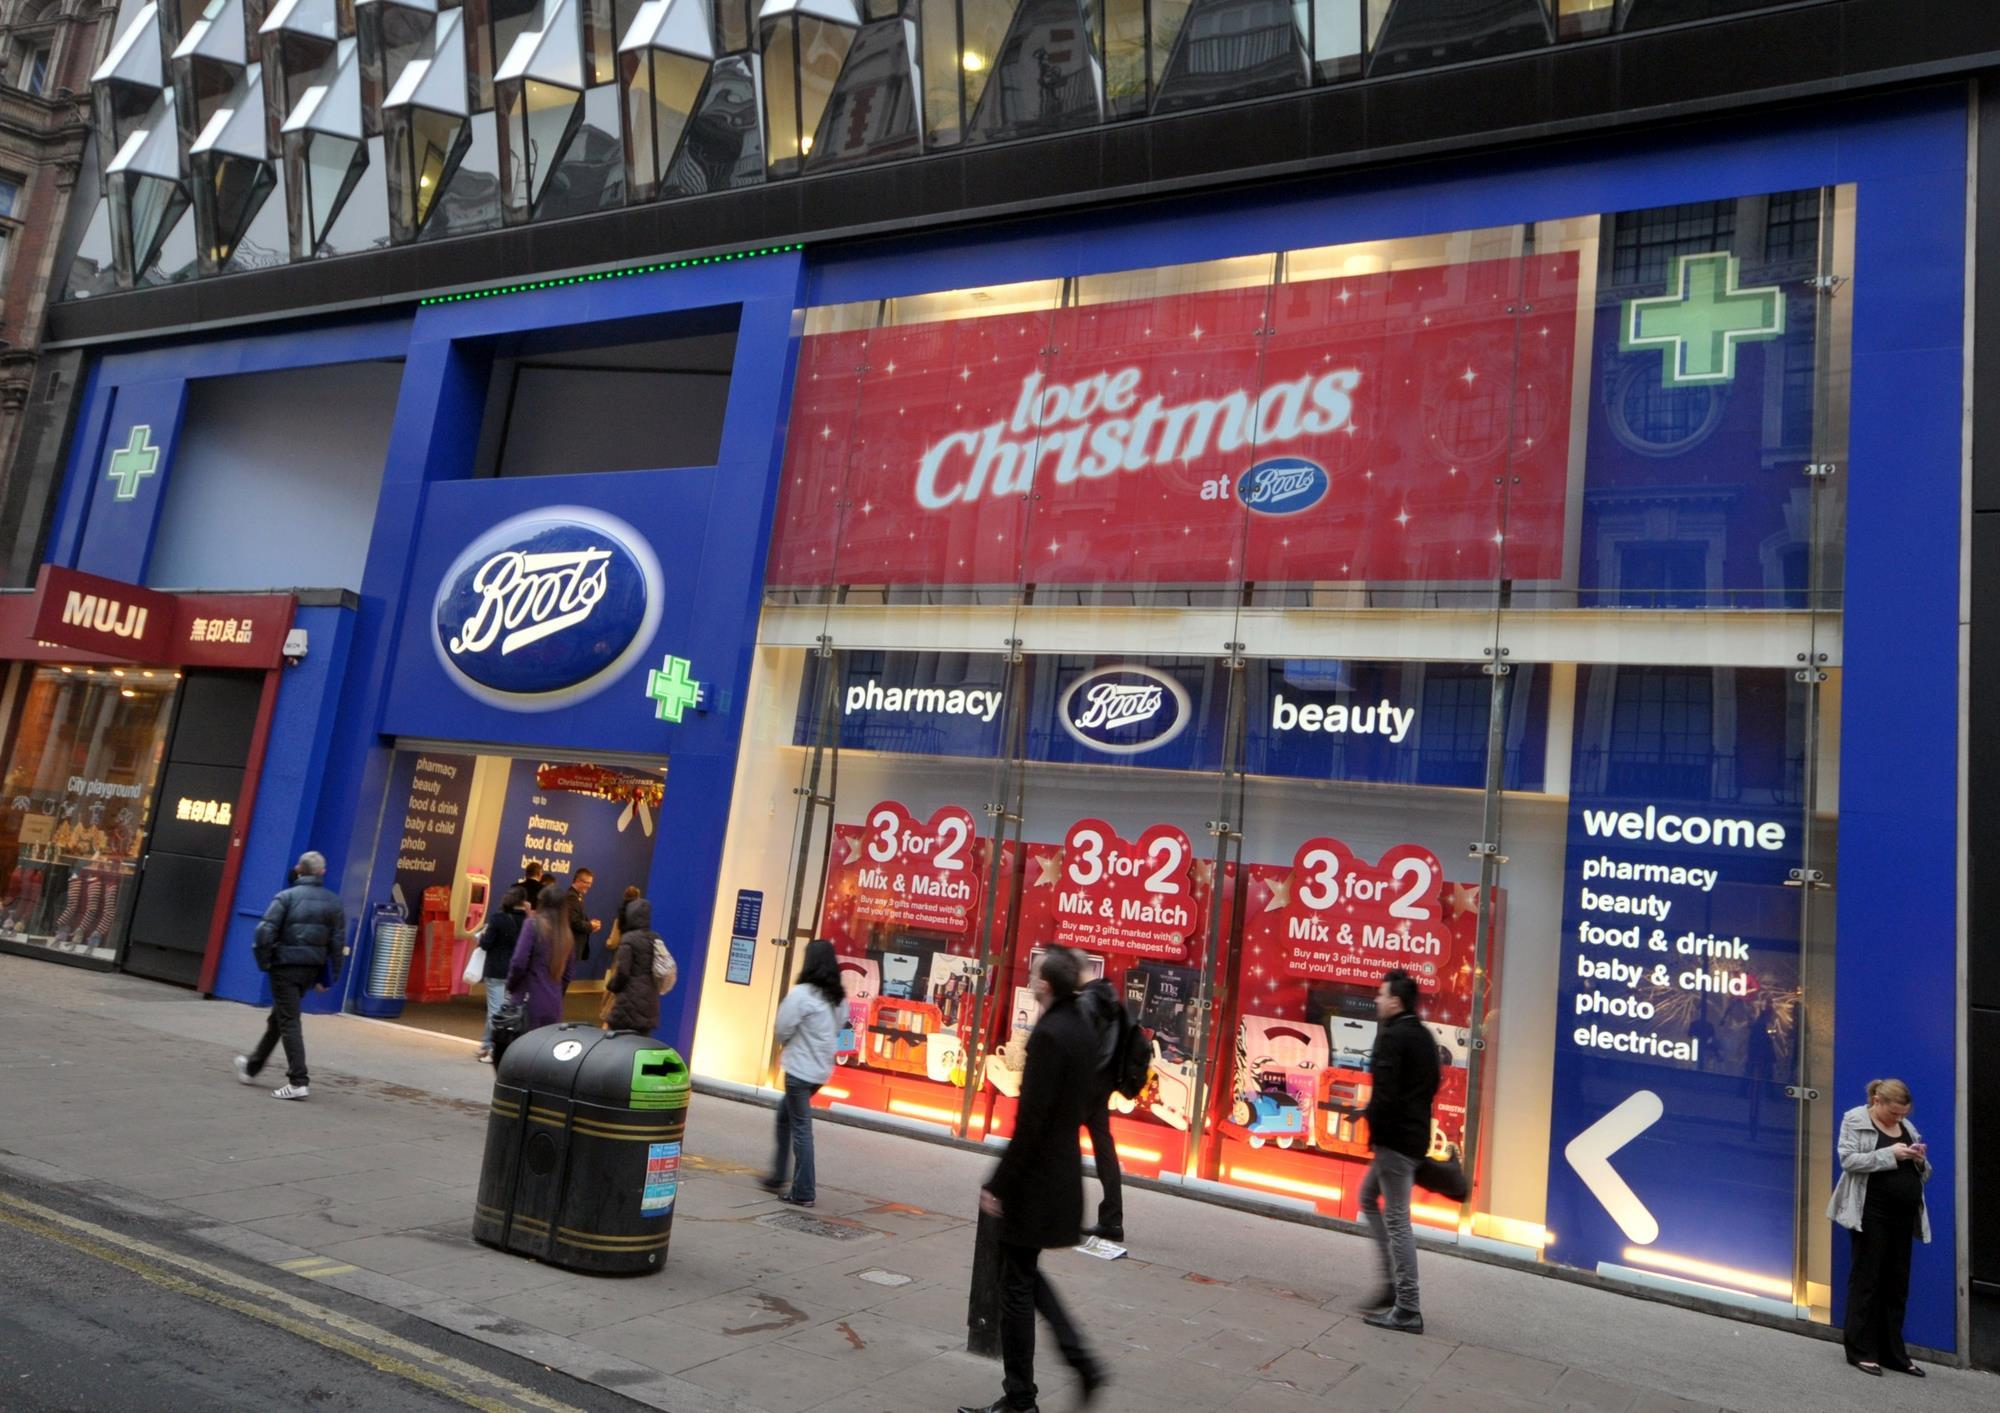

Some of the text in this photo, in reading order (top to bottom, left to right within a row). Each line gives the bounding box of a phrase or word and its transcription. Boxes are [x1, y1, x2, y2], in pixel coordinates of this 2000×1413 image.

[1011, 367, 1141, 432] love
[915, 369, 1361, 509] Christmas
[1200, 466, 1315, 503] at Boots
[62, 590, 149, 640] MUJI
[449, 546, 613, 656] Boots
[190, 618, 253, 643] 無印良品
[845, 679, 1002, 722] pharmacy
[1074, 683, 1162, 730] Boots
[1272, 694, 1414, 743] beauty
[416, 757, 457, 779] pharmacy
[67, 776, 142, 799] City playground
[412, 776, 441, 796] beauty
[176, 797, 232, 825] 無印良品
[409, 795, 458, 816] food & drink
[405, 816, 456, 835] baby & child
[528, 814, 569, 835] pharmacy
[1583, 805, 1785, 850] welcome
[400, 835, 426, 851] photo
[525, 834, 574, 854] food & drink
[868, 811, 967, 870] 3 for 2
[397, 857, 436, 872] electrical
[543, 858, 549, 871] &
[551, 859, 570, 874] child
[1069, 830, 1182, 894] 3 for 2
[1582, 855, 1718, 892] pharmacy
[858, 869, 970, 900] Mix & Match
[1299, 849, 1432, 920] 3 for 2
[903, 910, 914, 919] the
[916, 913, 948, 924] cheapest
[949, 917, 964, 926] free
[911, 902, 938, 912] marked
[939, 905, 955, 914] with
[1058, 892, 1188, 926] Mix & Match
[1581, 887, 1672, 922] beauty
[1059, 931, 1073, 940] and
[1097, 936, 1110, 946] get
[1112, 937, 1125, 947] the
[1127, 940, 1163, 952] cheapest
[1165, 945, 1181, 954] free
[1062, 920, 1171, 941] Buy any 3 gifts marked with
[1288, 916, 1440, 956] Mix & Match
[1579, 921, 1750, 961] food & drink
[1289, 960, 1307, 970] and
[1336, 966, 1351, 977] get
[1353, 968, 1368, 979] the
[1416, 975, 1435, 986] free
[1293, 947, 1422, 972] Buy any 3 gifts marked with
[1578, 954, 1747, 996] baby & child
[1575, 990, 1655, 1020] photo
[1573, 1024, 1698, 1062] electrical
